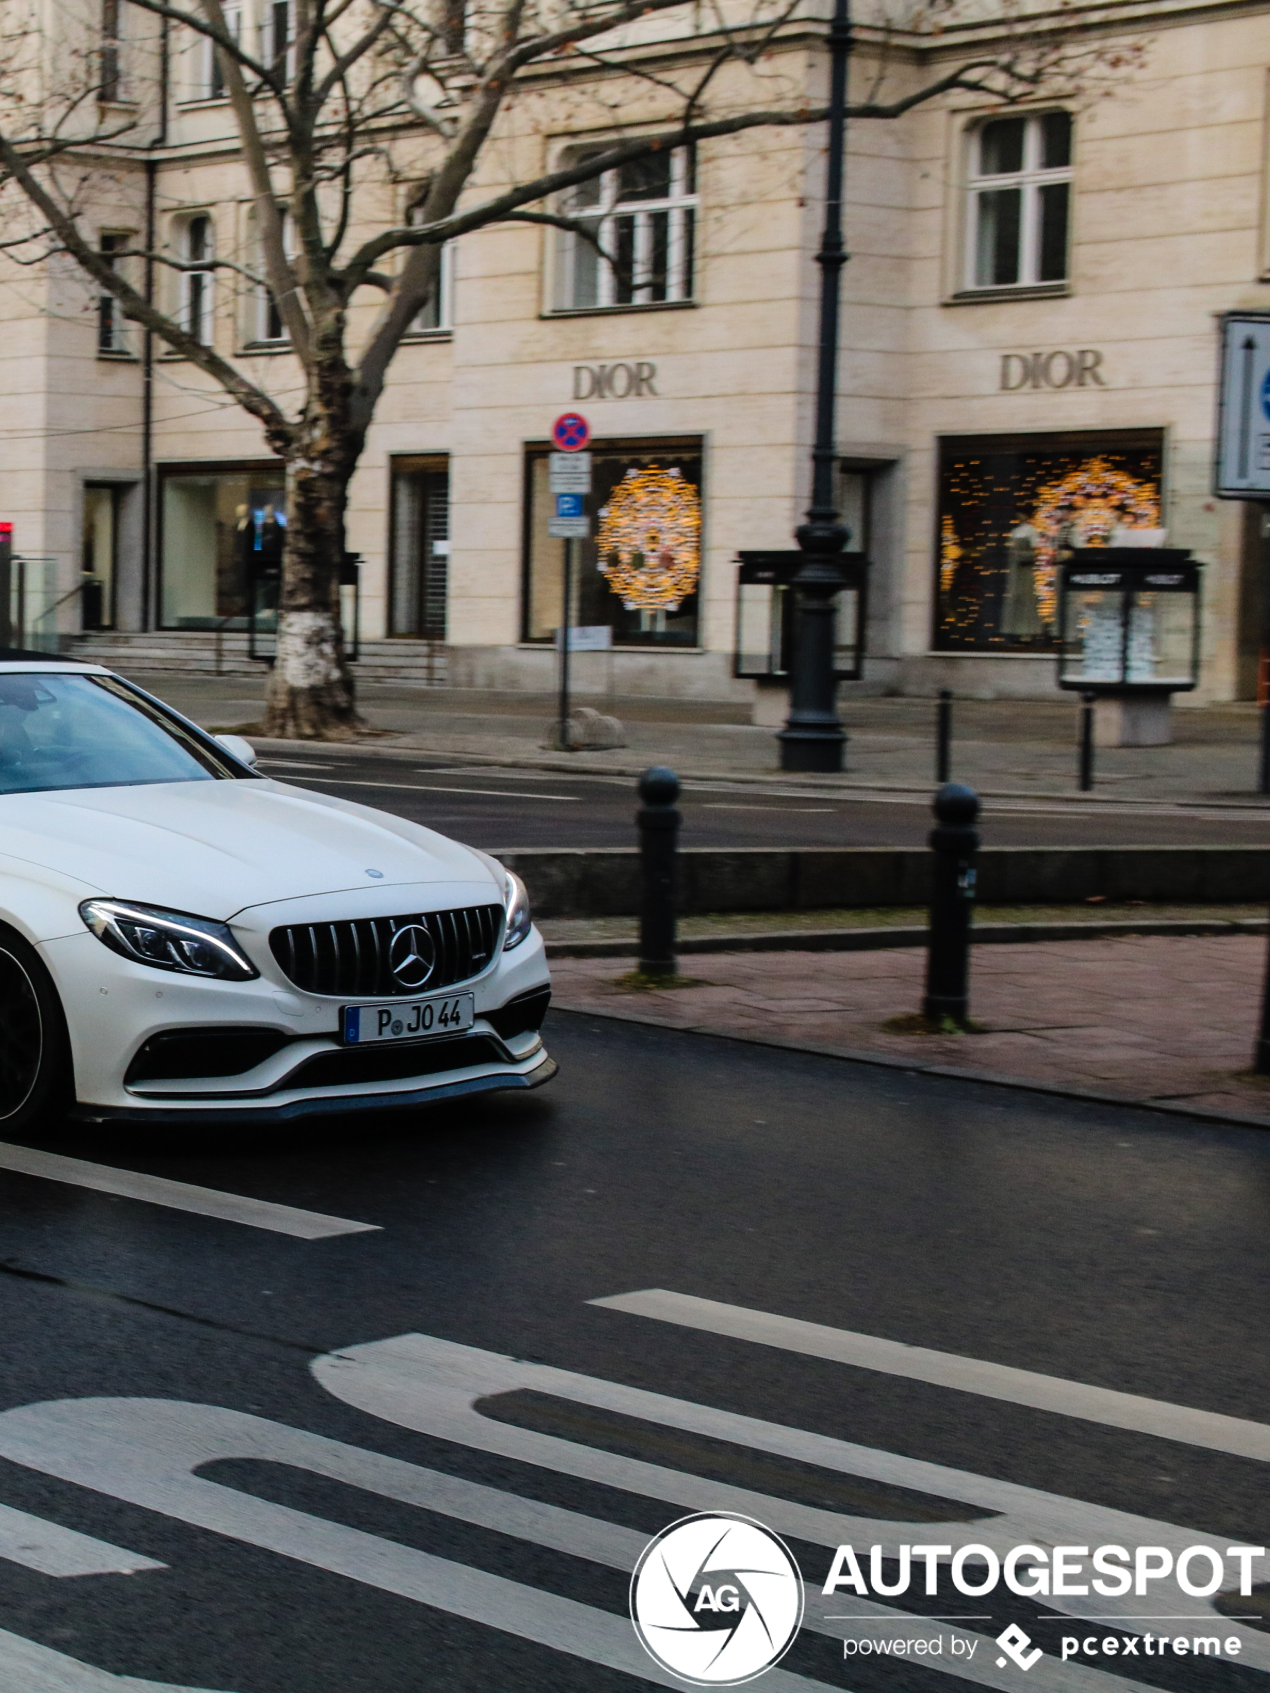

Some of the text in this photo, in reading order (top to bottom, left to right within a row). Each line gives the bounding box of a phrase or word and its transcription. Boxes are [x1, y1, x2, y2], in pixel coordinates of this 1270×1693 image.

[573, 362, 660, 400] DIOR
[999, 349, 1106, 391] DIOR
[378, 1009, 392, 1036] P
[407, 1004, 434, 1033] JO
[438, 999, 461, 1027] 44
